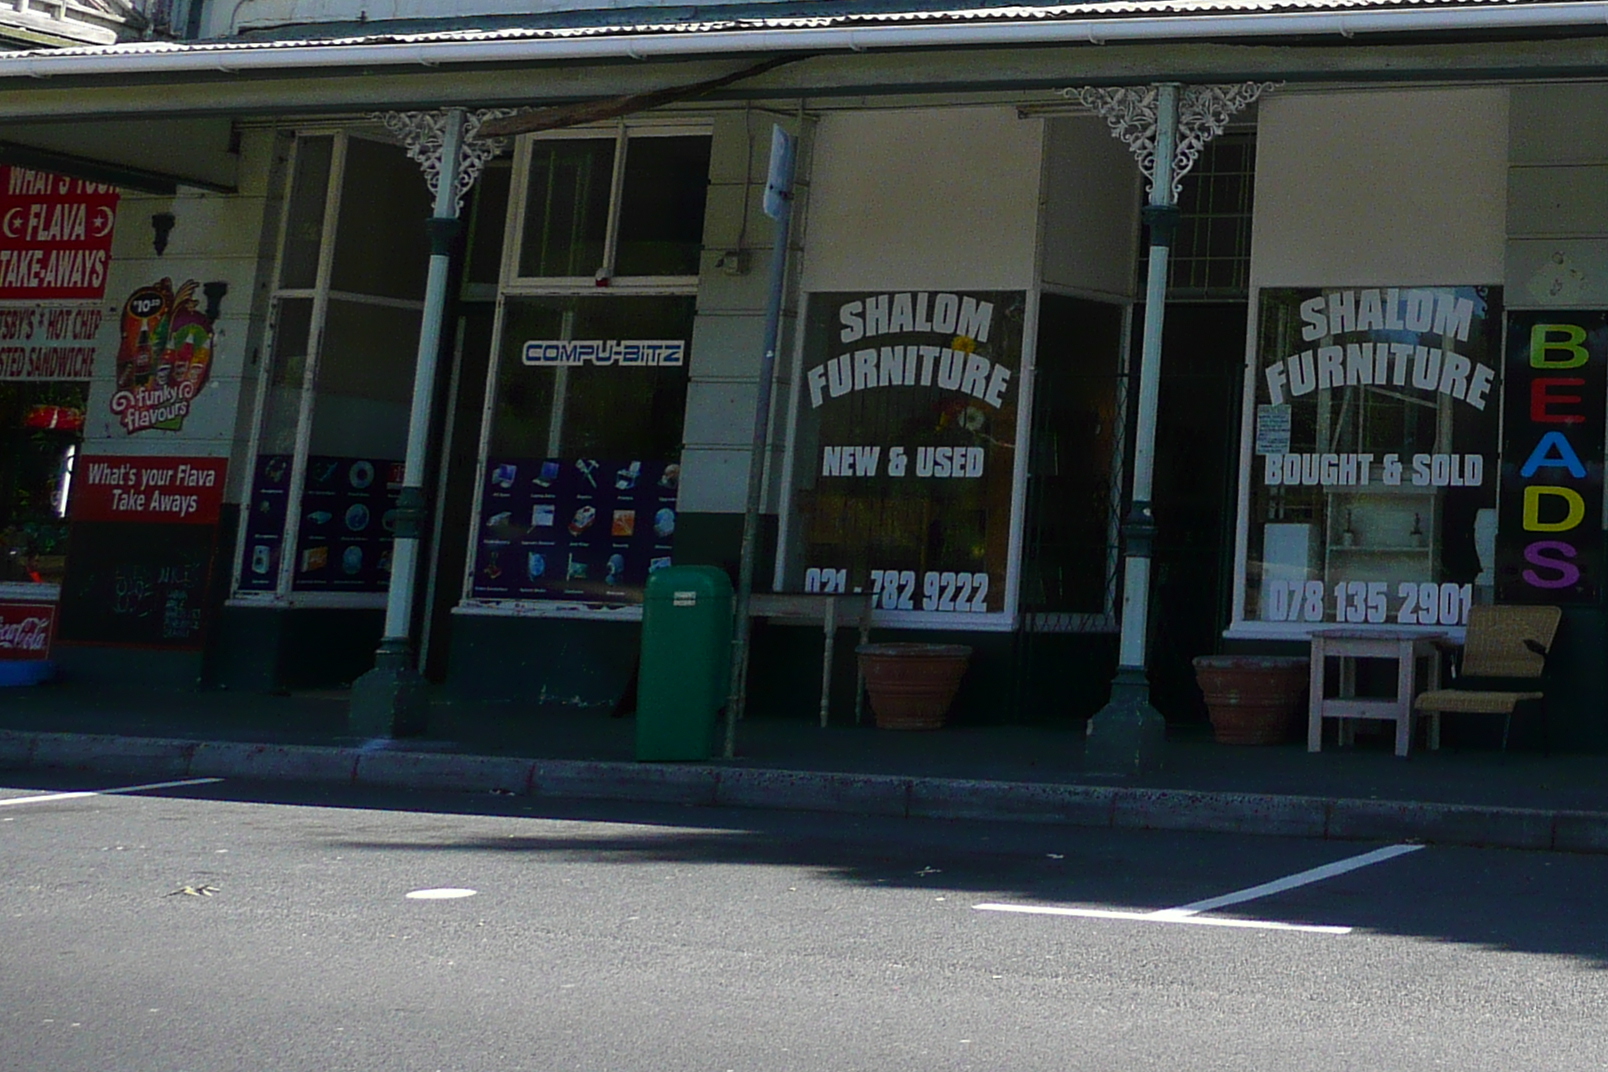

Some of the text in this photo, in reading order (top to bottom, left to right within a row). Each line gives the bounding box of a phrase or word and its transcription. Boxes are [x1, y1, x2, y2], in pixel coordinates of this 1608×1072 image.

[26, 203, 87, 241] FLAVA
[0, 249, 106, 288] TAKE-AWAYS
[46, 310, 72, 340] HOT
[839, 292, 994, 343] SHALOM
[1300, 288, 1474, 342] SHALOM
[0, 347, 25, 377] STED
[807, 345, 1011, 409] FURNITURE
[1265, 342, 1496, 411] FURNITURE
[136, 385, 178, 407] funky
[124, 401, 187, 431] flavours
[822, 446, 985, 478] NEW & USED
[1264, 453, 1484, 487] BOUGHT & SOLD
[1519, 323, 1591, 589] BEADS
[88, 463, 216, 491] What's your Flava
[112, 489, 198, 518] Take Aways
[870, 570, 916, 609] 782
[922, 571, 989, 613] 9222
[1270, 580, 1473, 625] 078 135 2901
